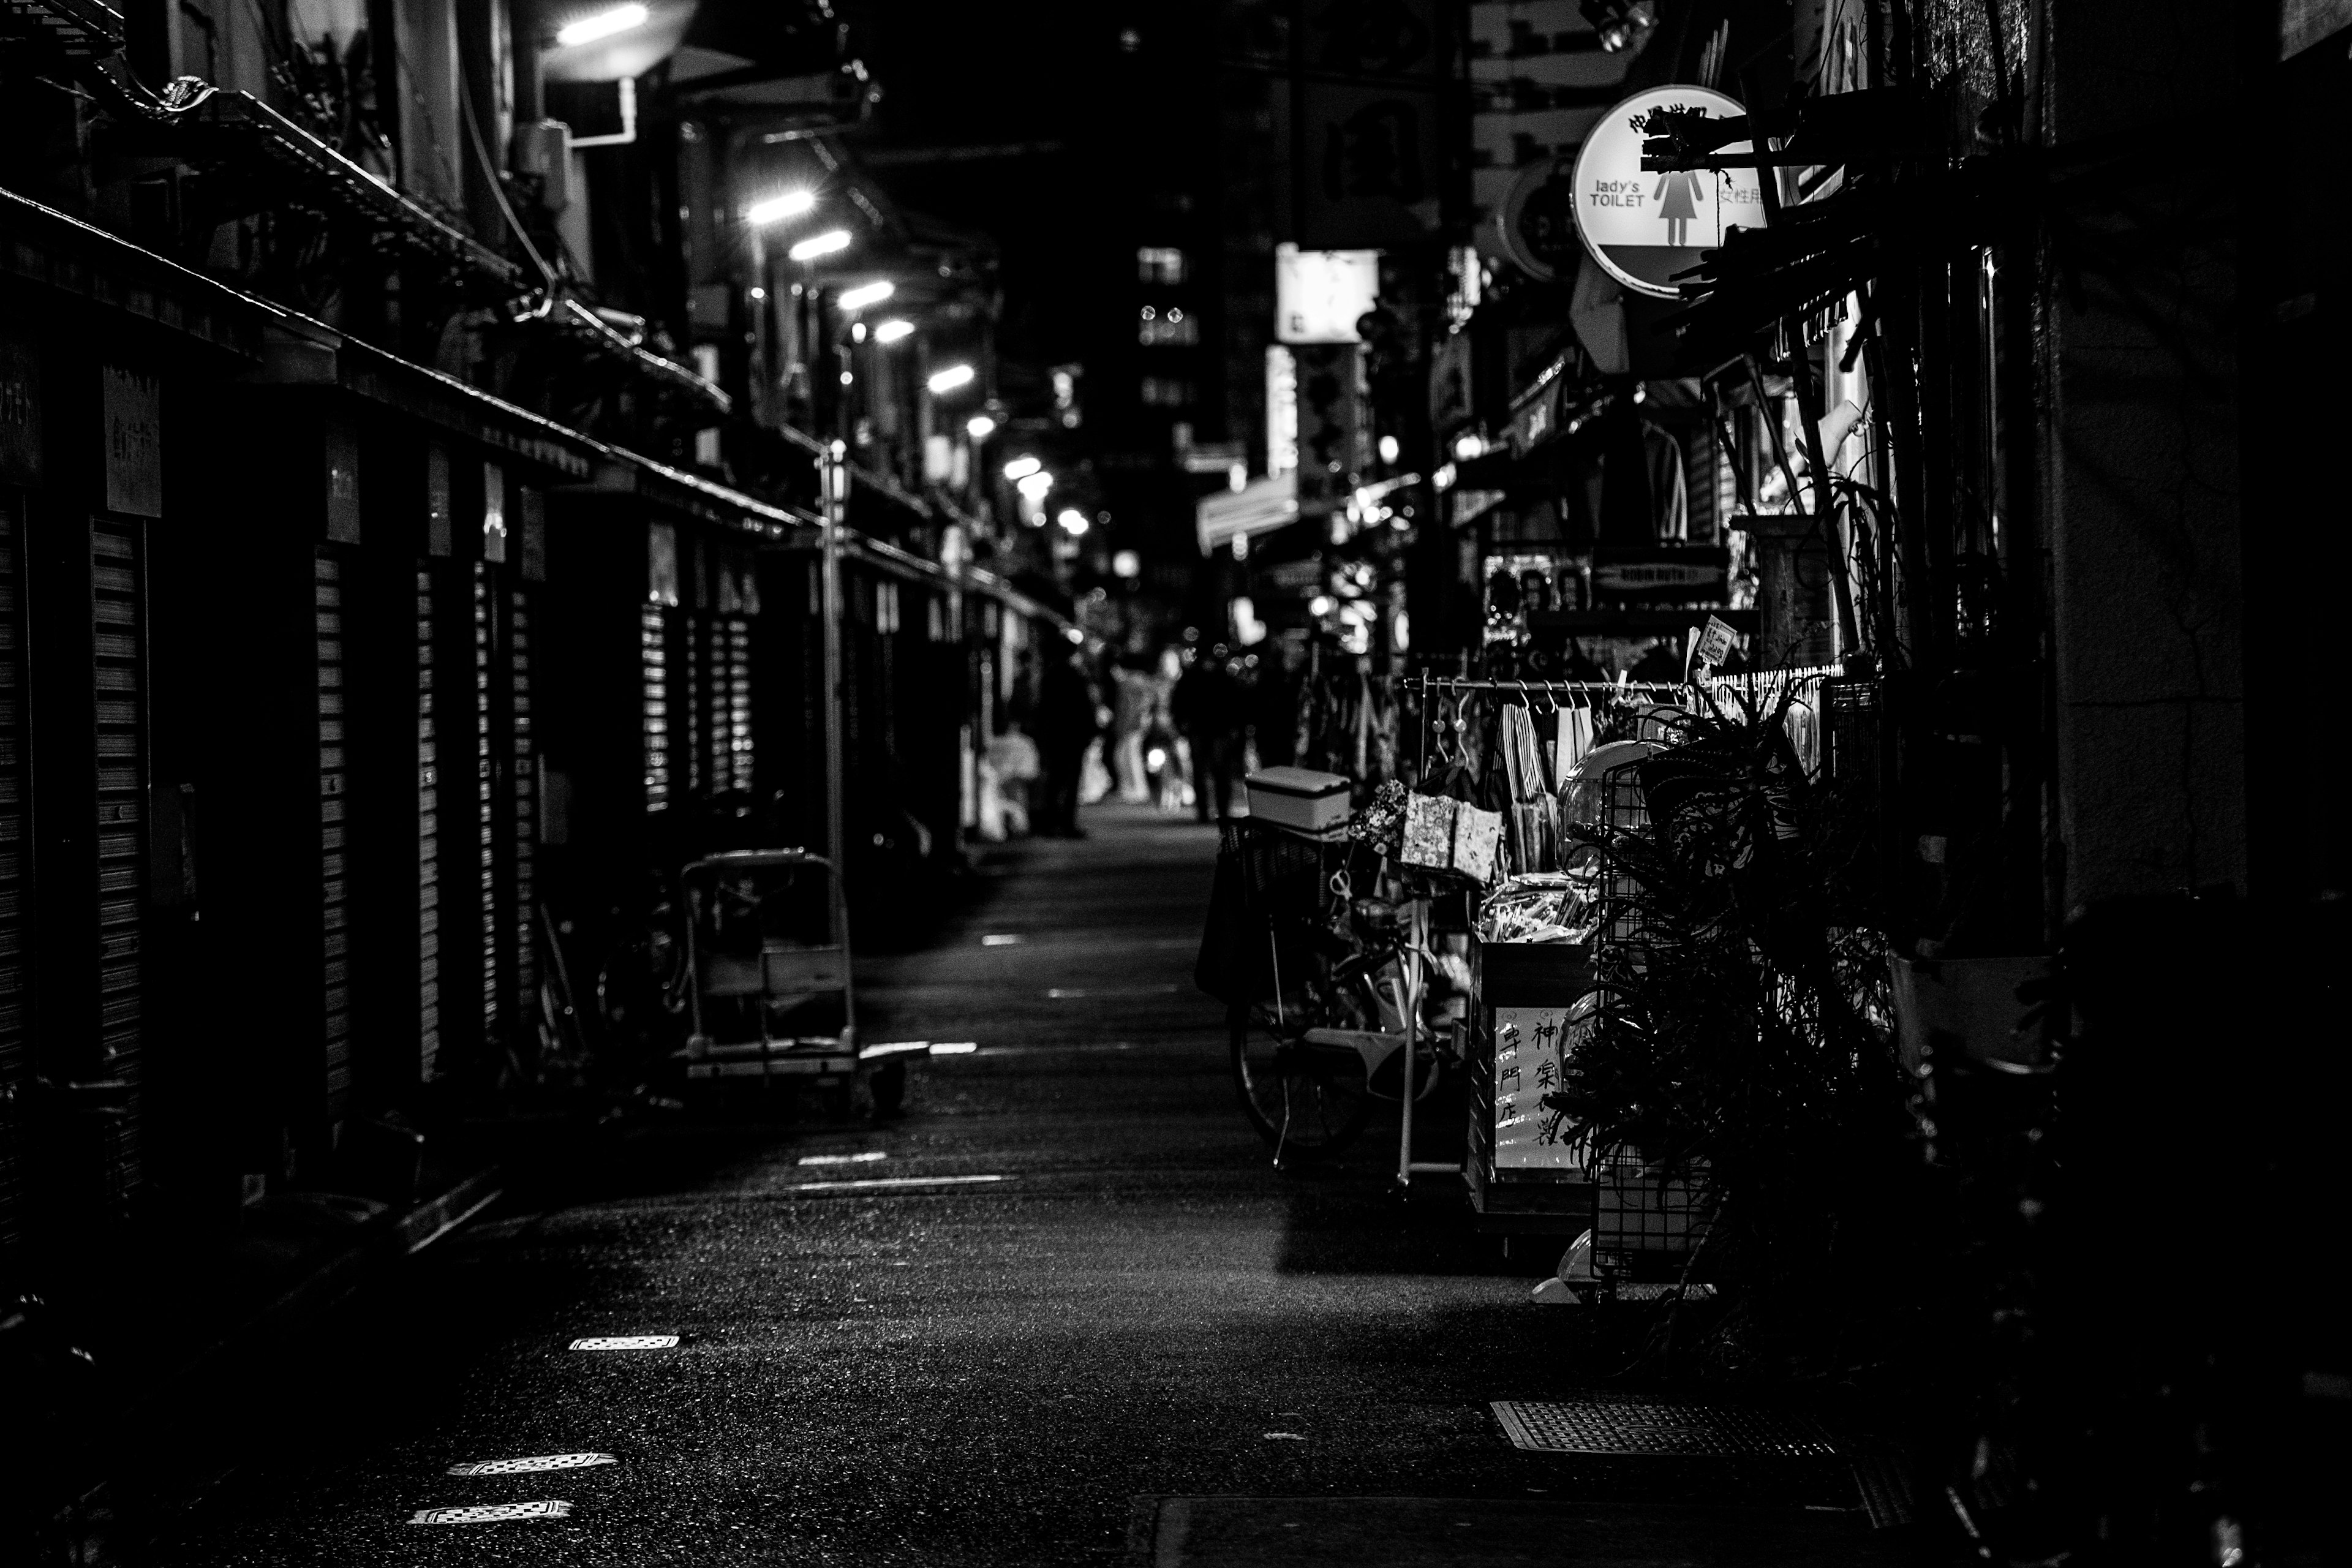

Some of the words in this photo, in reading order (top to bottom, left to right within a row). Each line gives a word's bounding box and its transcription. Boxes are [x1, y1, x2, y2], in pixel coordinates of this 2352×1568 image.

[1596, 179, 1640, 194] lady's
[1590, 194, 1645, 207] TOILET
[1719, 187, 1760, 204] 女性用
